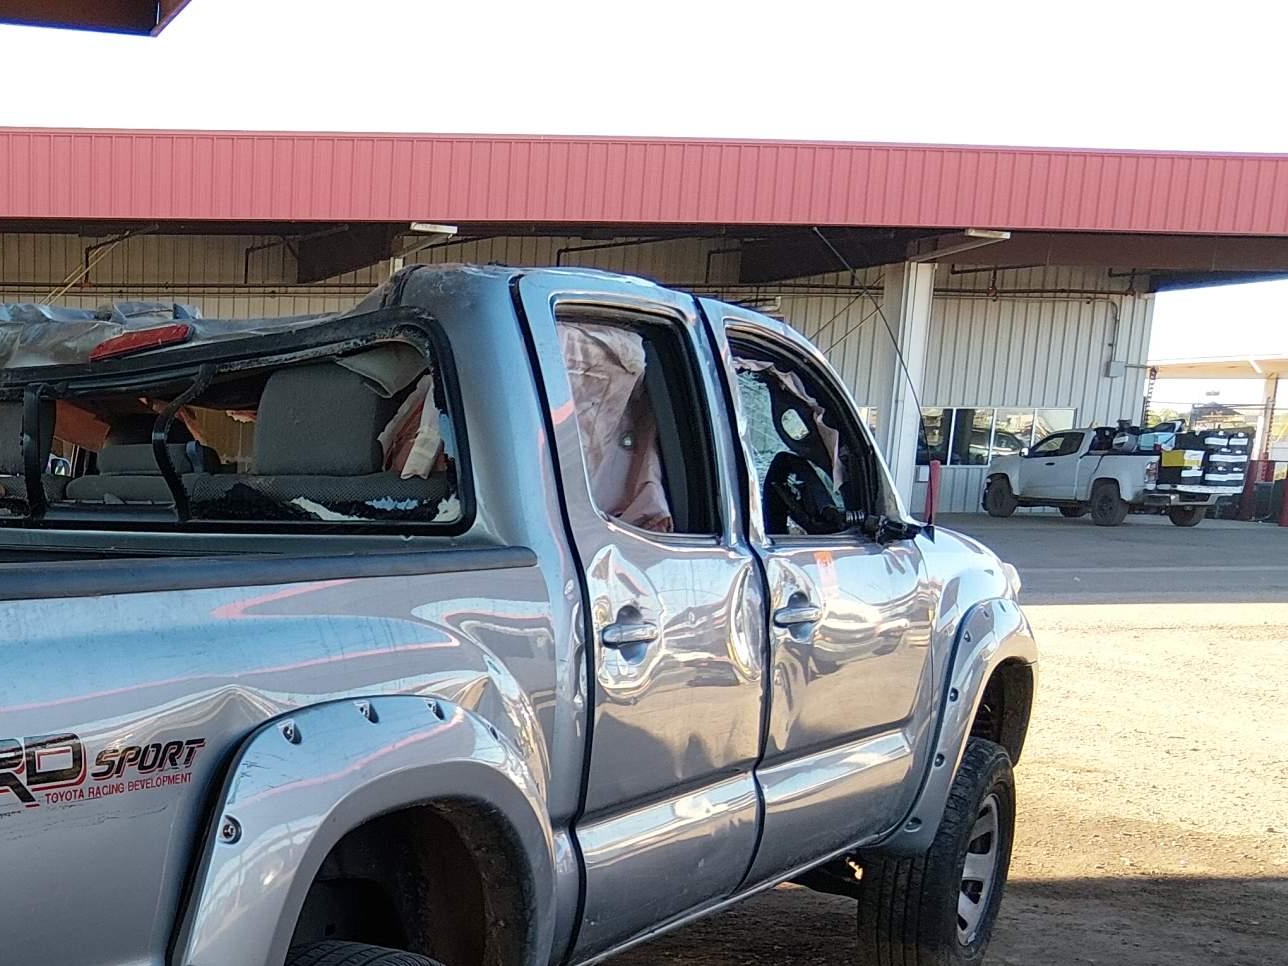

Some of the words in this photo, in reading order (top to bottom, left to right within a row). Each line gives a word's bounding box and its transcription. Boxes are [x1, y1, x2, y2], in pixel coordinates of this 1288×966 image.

[91, 738, 206, 781] SPORT
[45, 789, 85, 804] TOYOTA
[87, 782, 125, 799] RACING
[127, 772, 193, 791] DEVELOPMENT
